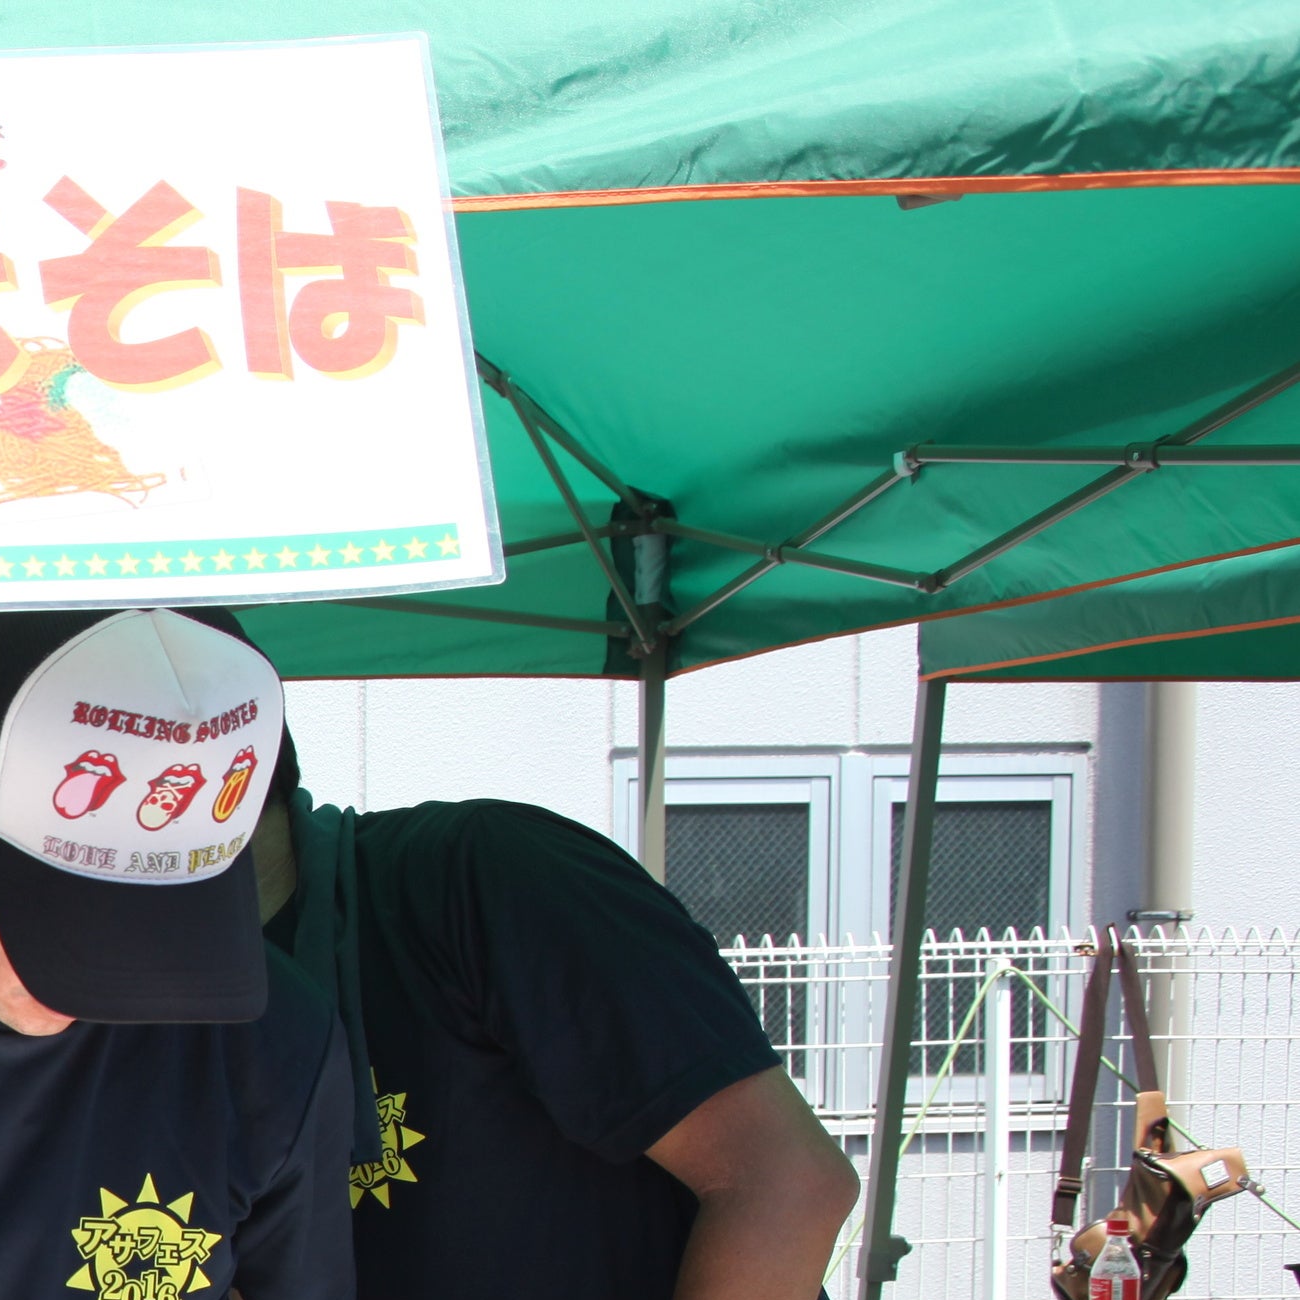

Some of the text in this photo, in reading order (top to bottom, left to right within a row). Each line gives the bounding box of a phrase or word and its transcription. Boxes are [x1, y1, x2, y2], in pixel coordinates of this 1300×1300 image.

[71, 698, 258, 744] ROLLING STONES
[124, 851, 181, 873] AND
